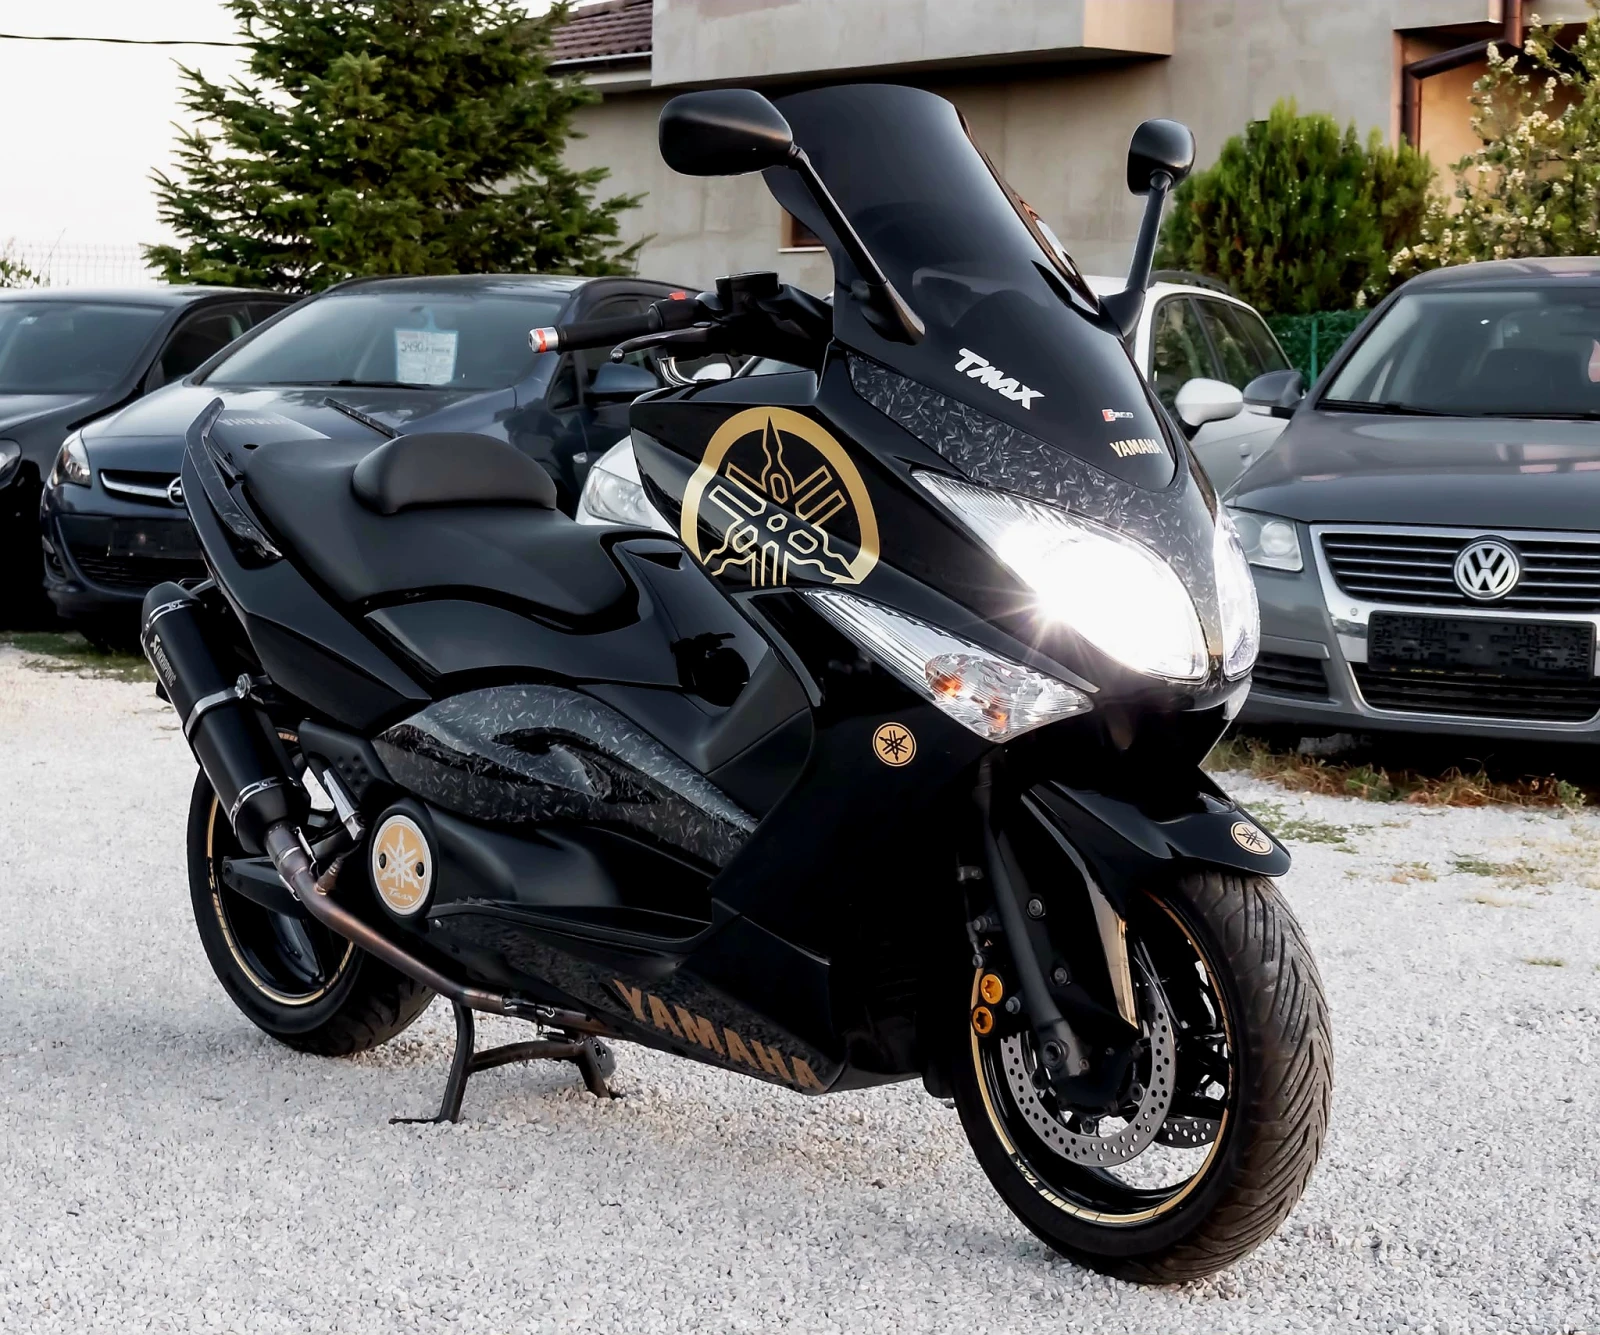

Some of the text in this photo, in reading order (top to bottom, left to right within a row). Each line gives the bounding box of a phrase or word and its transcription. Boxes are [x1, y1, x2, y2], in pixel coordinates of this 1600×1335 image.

[954, 347, 1045, 410] TMAX
[1109, 438, 1164, 457] YAMAHA
[1458, 543, 1515, 597] VW
[612, 978, 826, 1093] YAMAHA
